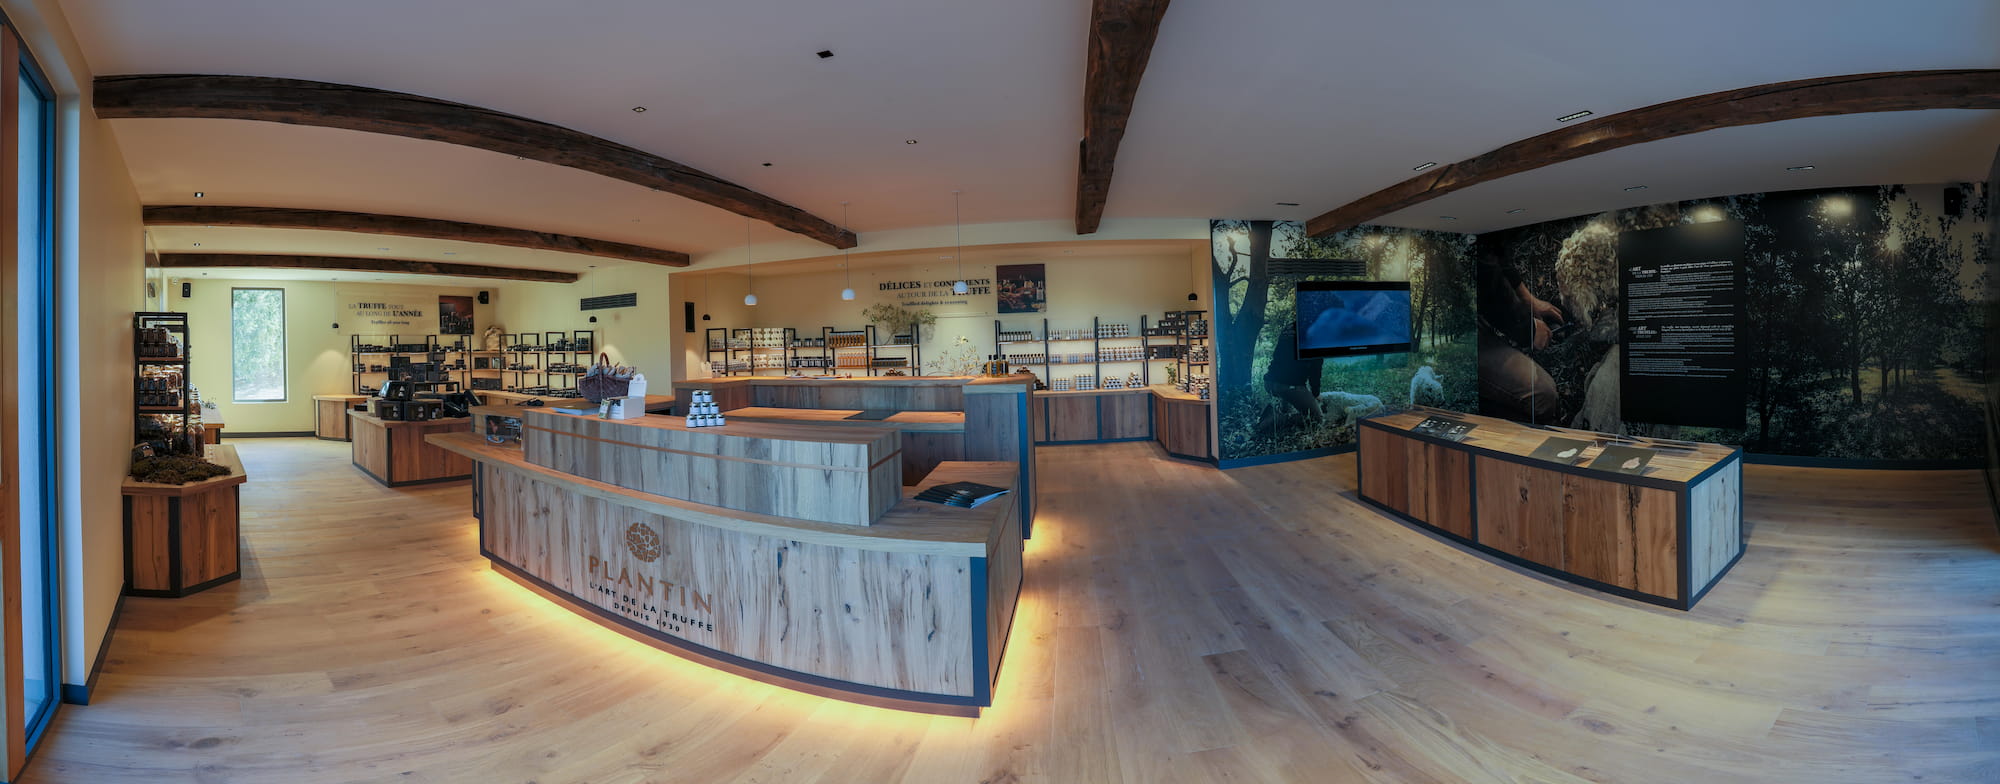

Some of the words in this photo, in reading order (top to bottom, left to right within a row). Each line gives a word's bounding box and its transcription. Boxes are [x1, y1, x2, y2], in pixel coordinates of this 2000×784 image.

[879, 280, 921, 291] DÉLICES
[896, 291, 926, 299] AUTOUR
[588, 555, 713, 615] PLANTIN
[589, 581, 617, 598] L'ART
[622, 594, 636, 606] DE
[643, 602, 657, 614] LA
[663, 609, 713, 632] TRUFFE
[614, 602, 650, 622] DEPUIS
[656, 619, 680, 632] 1930
